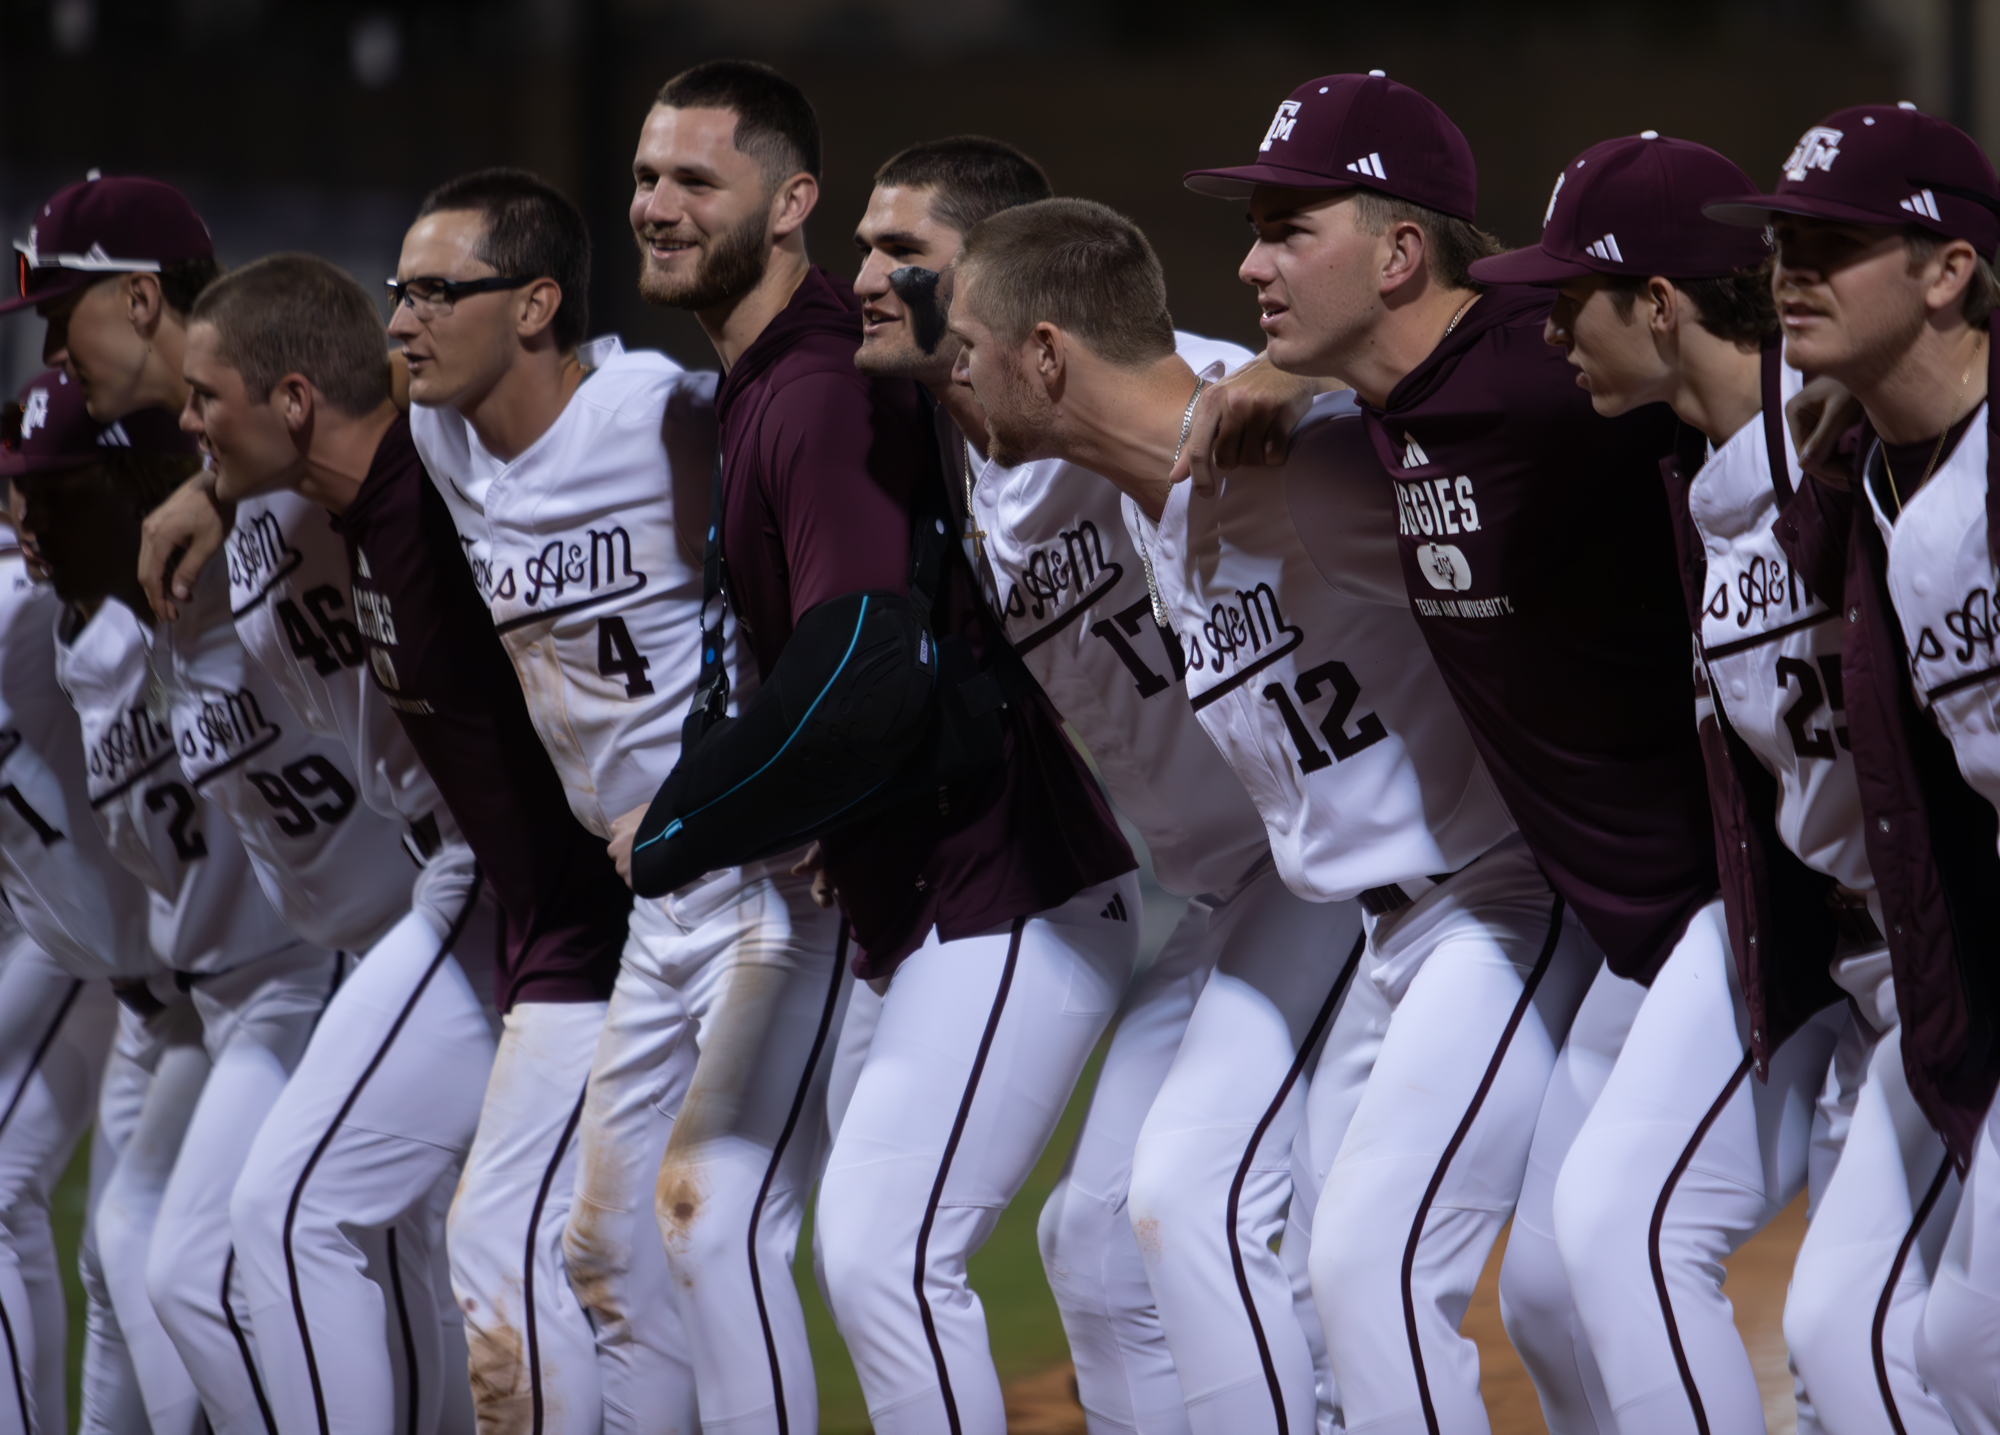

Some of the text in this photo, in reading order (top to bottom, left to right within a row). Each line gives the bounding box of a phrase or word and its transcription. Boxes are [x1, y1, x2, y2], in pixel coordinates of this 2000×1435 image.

[1393, 475, 1478, 536] AGGIES
[525, 525, 647, 606] A&M
[1022, 520, 1123, 620] A&M
[1414, 598, 1443, 617] TEXAS
[1457, 595, 1511, 618] UNIVERSITY
[276, 584, 364, 677] 46
[597, 616, 655, 699] 4
[1090, 593, 1187, 700] 17
[1203, 582, 1303, 673] A&M
[198, 688, 282, 758] A&M
[1262, 660, 1389, 776] 12
[145, 782, 208, 862] 2
[247, 755, 356, 837] 99
